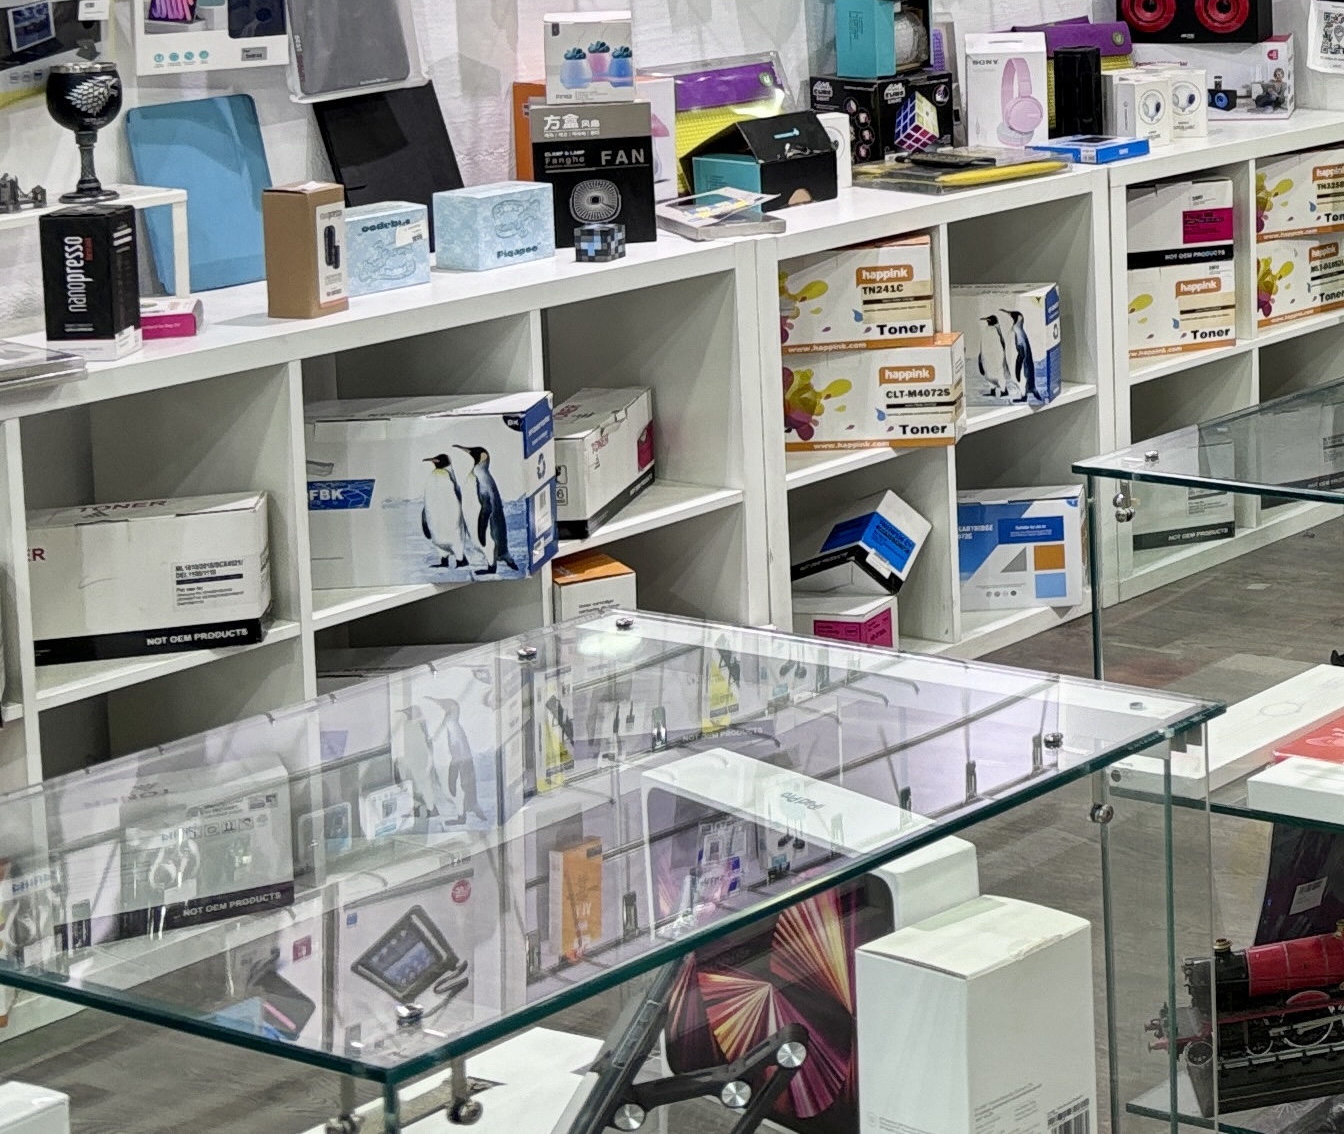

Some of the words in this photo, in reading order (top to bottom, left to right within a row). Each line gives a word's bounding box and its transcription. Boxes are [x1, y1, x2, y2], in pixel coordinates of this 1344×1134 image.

[601, 149, 644, 165] FAN
[64, 236, 94, 313] nanopresso
[861, 269, 909, 282] happink
[863, 284, 904, 295] TN241C
[1179, 281, 1218, 293] happink
[1319, 290, 1344, 303] Toner
[876, 324, 926, 335] Toner
[1191, 328, 1230, 340] Toner
[885, 368, 930, 381] happink
[886, 389, 951, 399] CLT-M4072S
[899, 425, 947, 435] Toner
[79, 500, 168, 513] TONER
[147, 637, 168, 646] NOT
[170, 634, 192, 644] OEM
[194, 628, 249, 641] PRODUCTS
[183, 907, 203, 917] NOT
[206, 903, 227, 913] OEM
[229, 892, 281, 908] PRODUCTS
